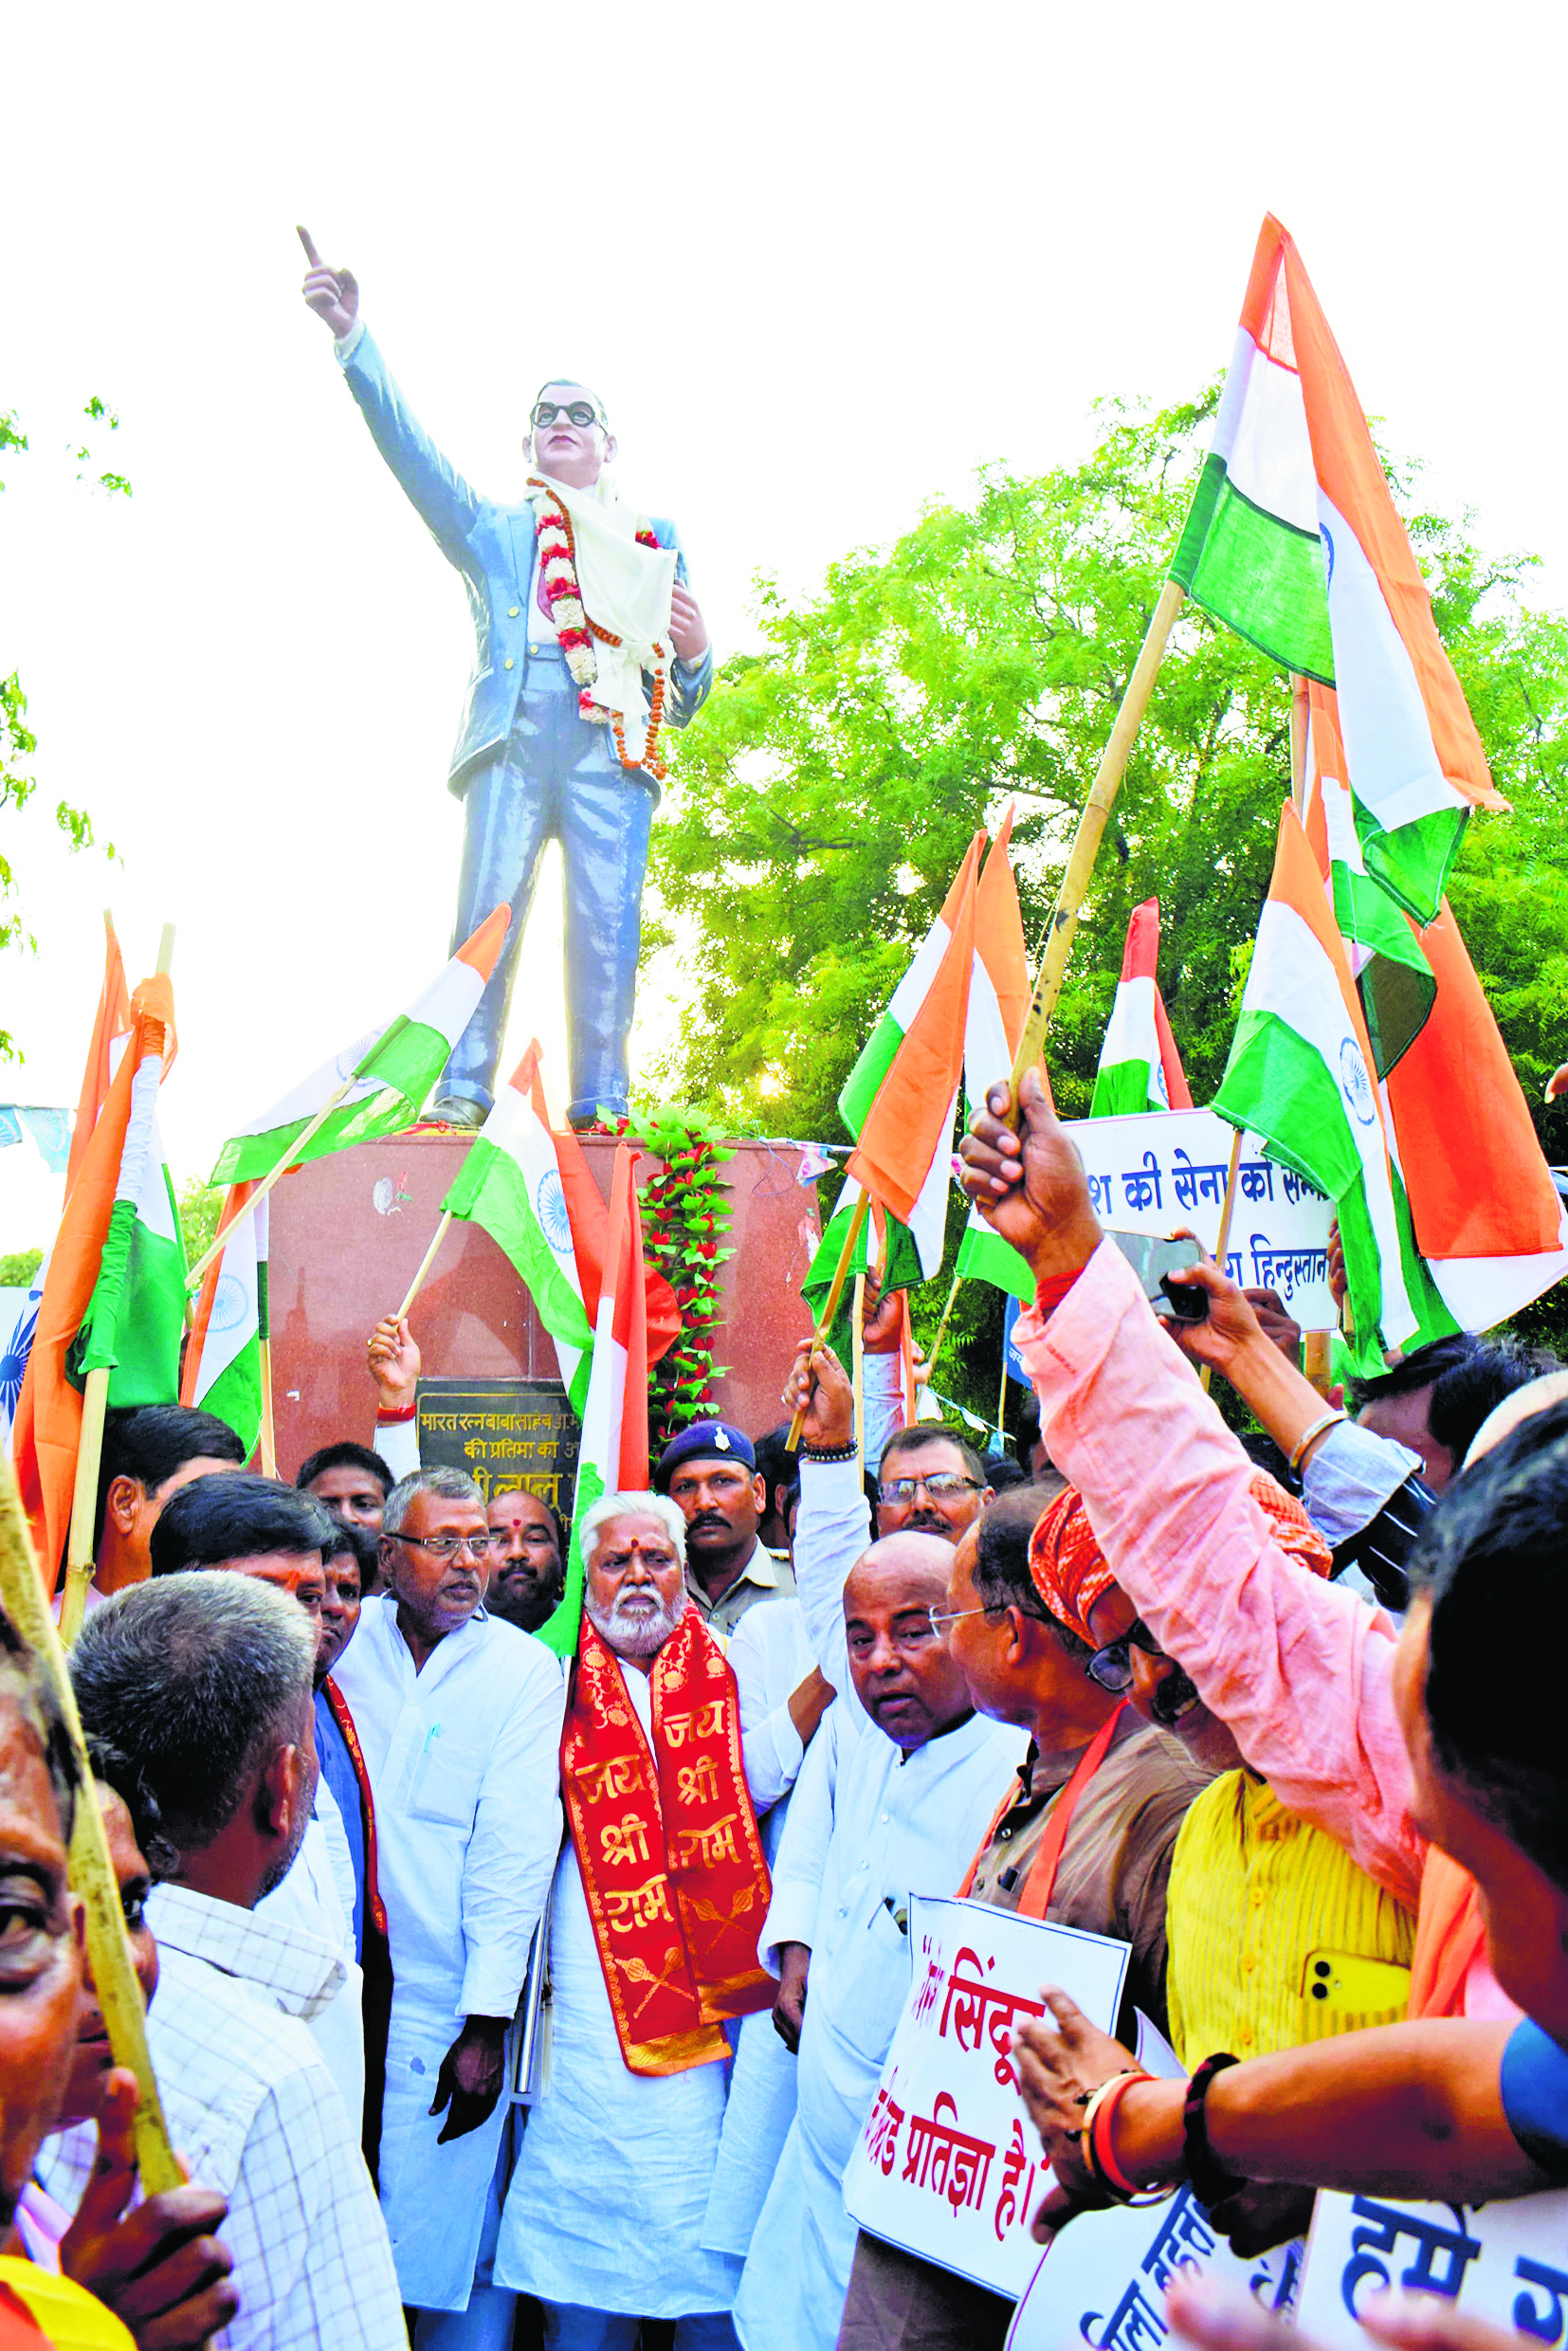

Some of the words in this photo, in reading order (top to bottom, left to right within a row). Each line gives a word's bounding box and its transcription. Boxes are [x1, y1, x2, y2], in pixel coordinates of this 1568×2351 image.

[1121, 1151, 1162, 1212] की
[1172, 1148, 1229, 1211] सेना
[420, 1413, 458, 1432] भारत
[464, 1438, 487, 1460] की
[489, 1438, 536, 1460] प्रतिमा
[537, 1442, 559, 1459] का
[664, 1700, 726, 1749] जय
[574, 1754, 647, 1805] जय
[676, 1754, 720, 1806] श्री
[600, 1813, 650, 1867] श्री
[678, 1812, 742, 1869] राम
[604, 1873, 675, 1934] राम
[939, 1946, 1047, 2097] सिंदू
[902, 2090, 996, 2219] प्रतिज्ञा
